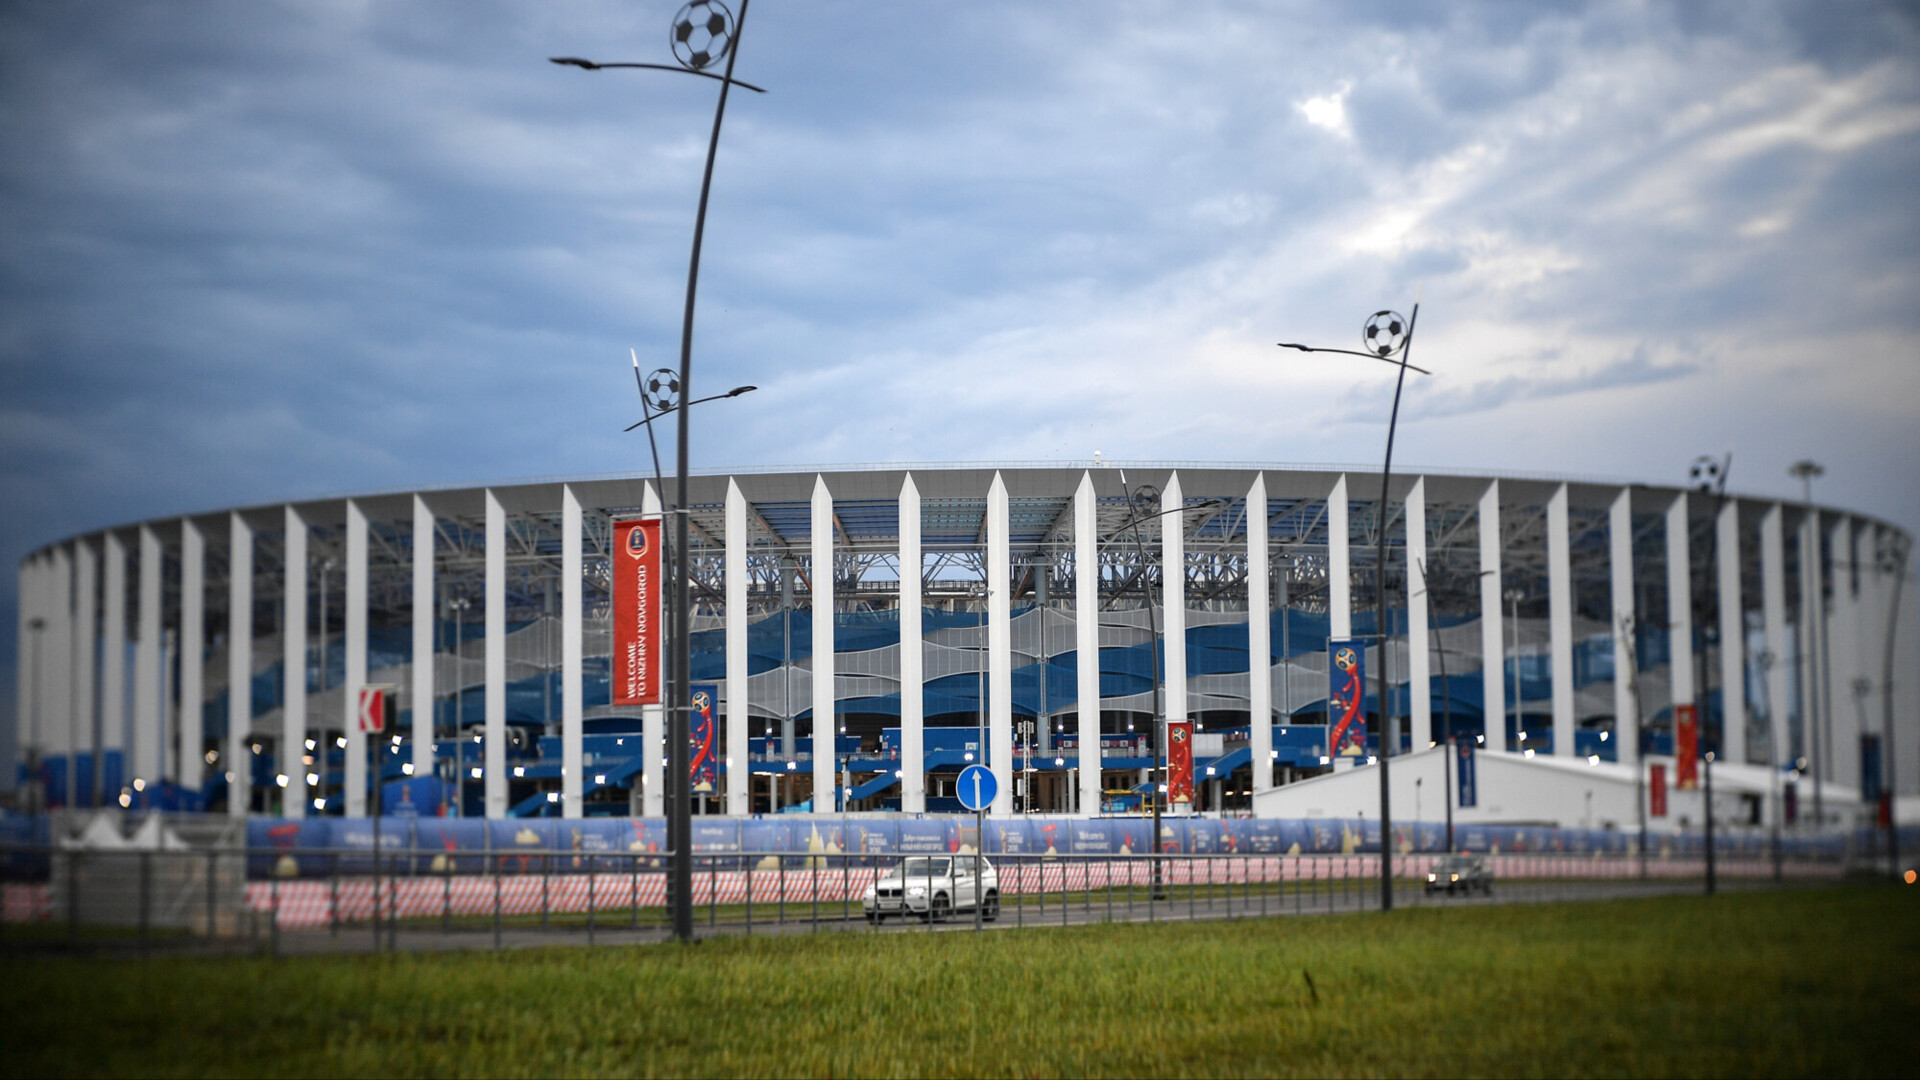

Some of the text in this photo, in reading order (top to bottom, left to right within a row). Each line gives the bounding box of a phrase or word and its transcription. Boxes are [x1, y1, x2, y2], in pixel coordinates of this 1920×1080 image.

[628, 642, 637, 698] WELCOME
[638, 565, 647, 697] TO NIZHNY NOVGOROD
